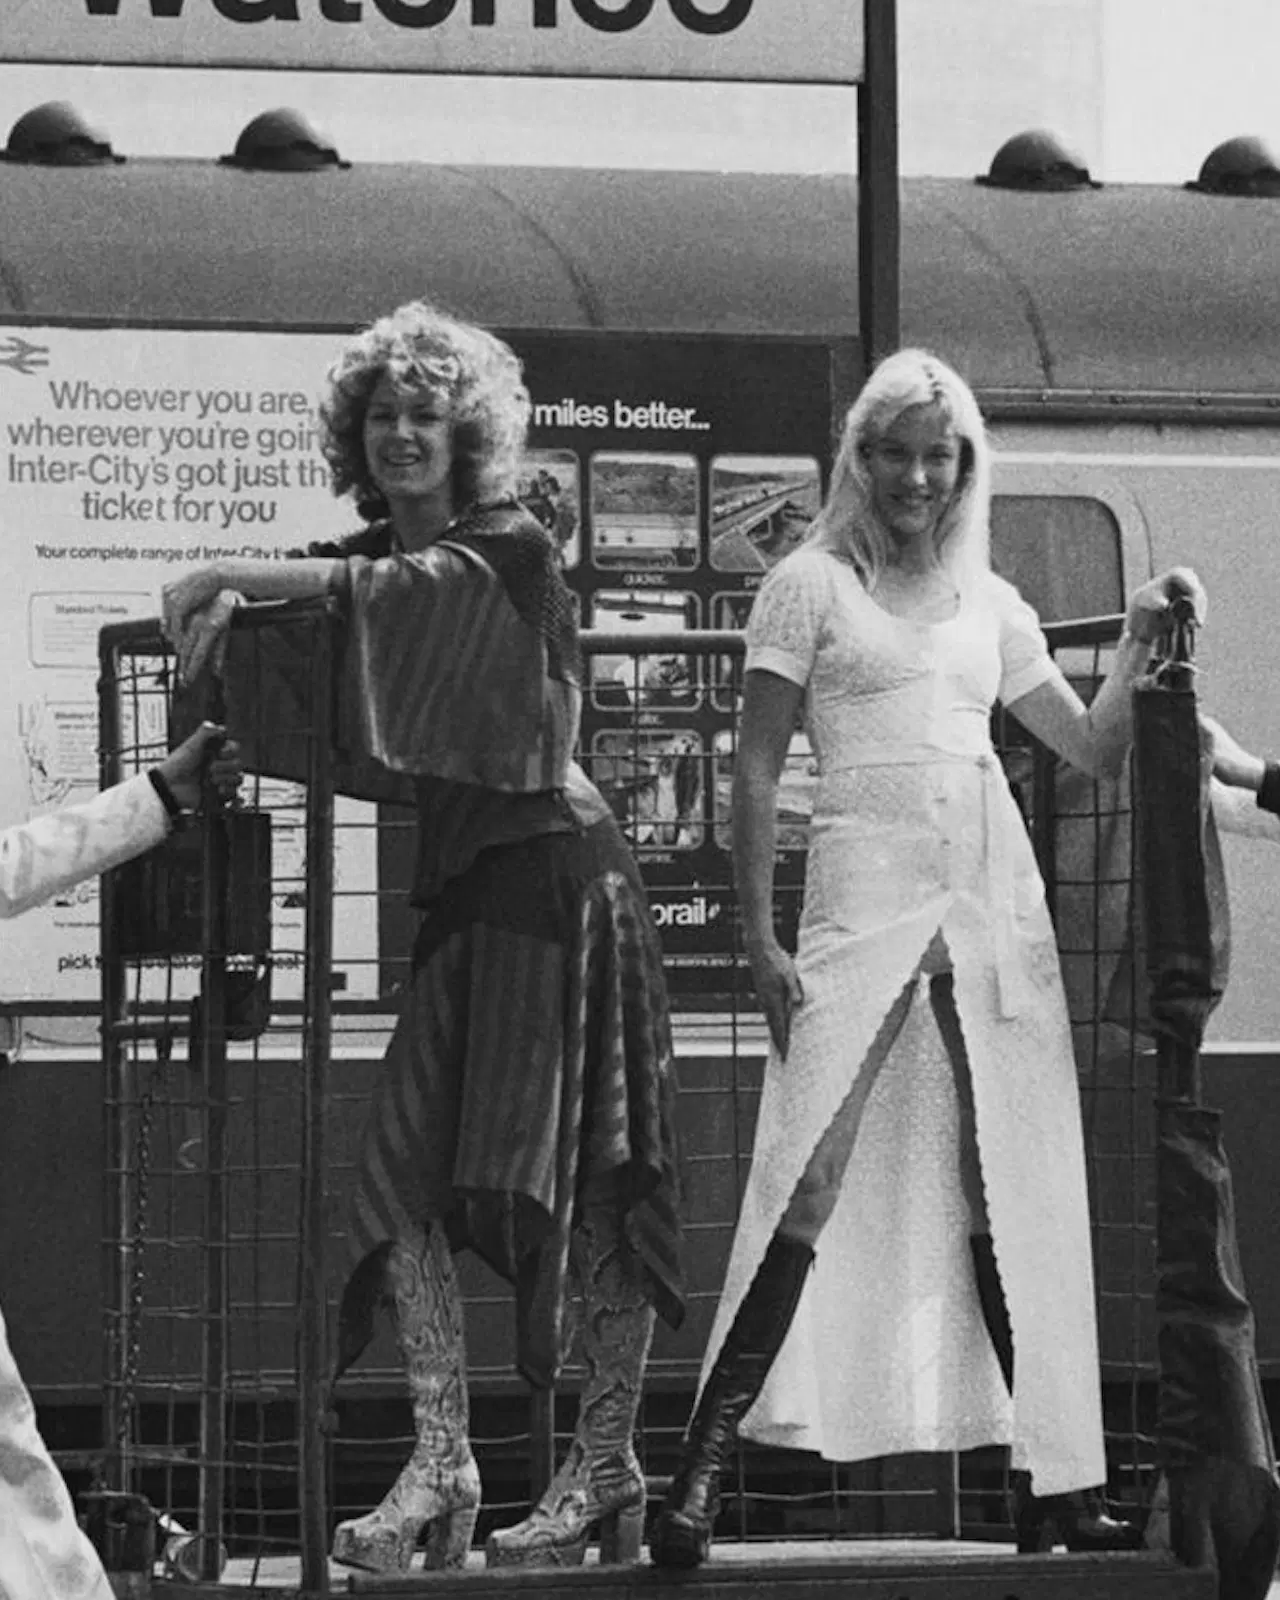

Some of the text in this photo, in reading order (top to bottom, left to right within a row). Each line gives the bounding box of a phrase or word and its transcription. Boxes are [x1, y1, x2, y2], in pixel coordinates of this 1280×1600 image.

[48, 380, 314, 420] Whoever you are,
[534, 399, 711, 430] miles better...
[7, 416, 321, 457] wherever you're goin
[8, 453, 333, 493] Inter-City's got just th
[81, 491, 277, 529] ticket for you
[34, 544, 68, 560] Your
[71, 544, 138, 562] complete
[141, 547, 183, 564] range
[185, 546, 201, 561] of
[650, 897, 706, 925] orail
